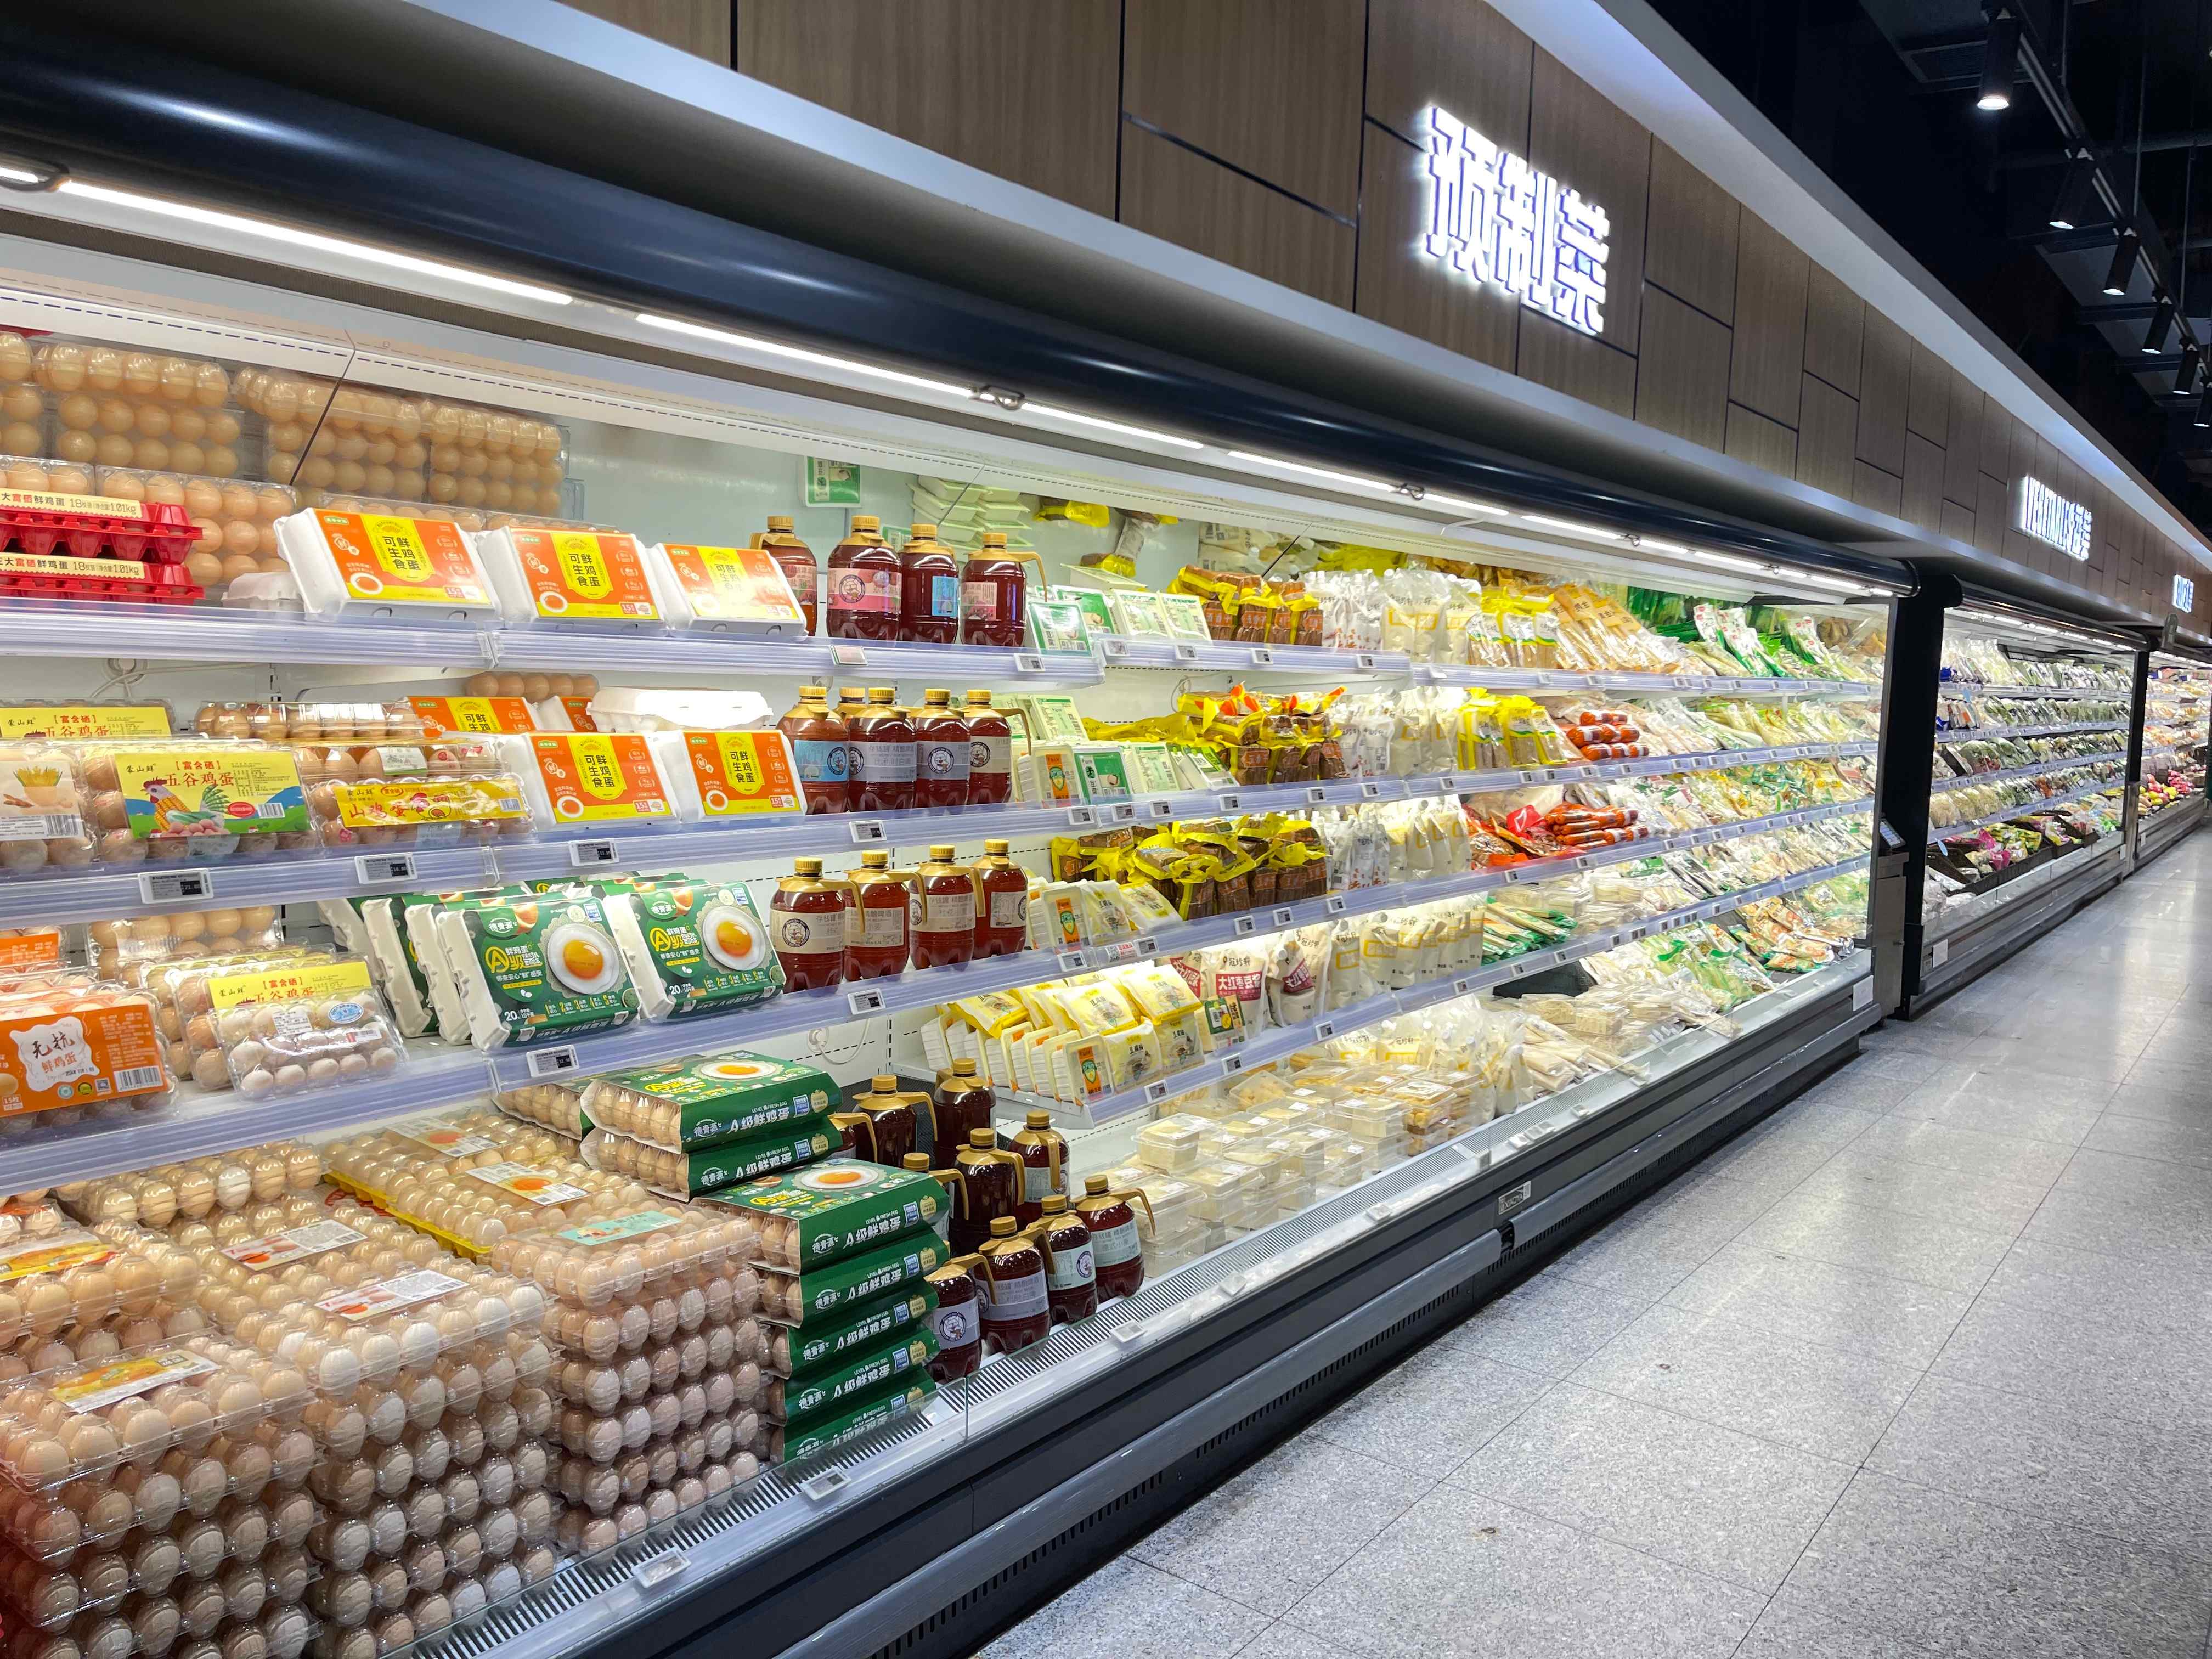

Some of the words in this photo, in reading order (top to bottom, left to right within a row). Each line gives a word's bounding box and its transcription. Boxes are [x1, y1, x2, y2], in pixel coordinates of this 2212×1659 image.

[165, 772, 235, 788] 五谷鸡蛋
[1218, 973, 1262, 990] 大红枣豆浆
[41, 1051, 78, 1074] 鲜鸡蛋
[727, 1107, 790, 1134] A级鲜鸡蛋
[732, 1152, 792, 1181] A级鲜鸡蛋
[843, 1216, 901, 1250] A级鲜鸡蛋
[844, 1268, 902, 1303] A级鲜鸡蛋
[833, 1317, 891, 1353] A级鲜鸡蛋
[830, 1364, 890, 1401] A级鲜鸡蛋
